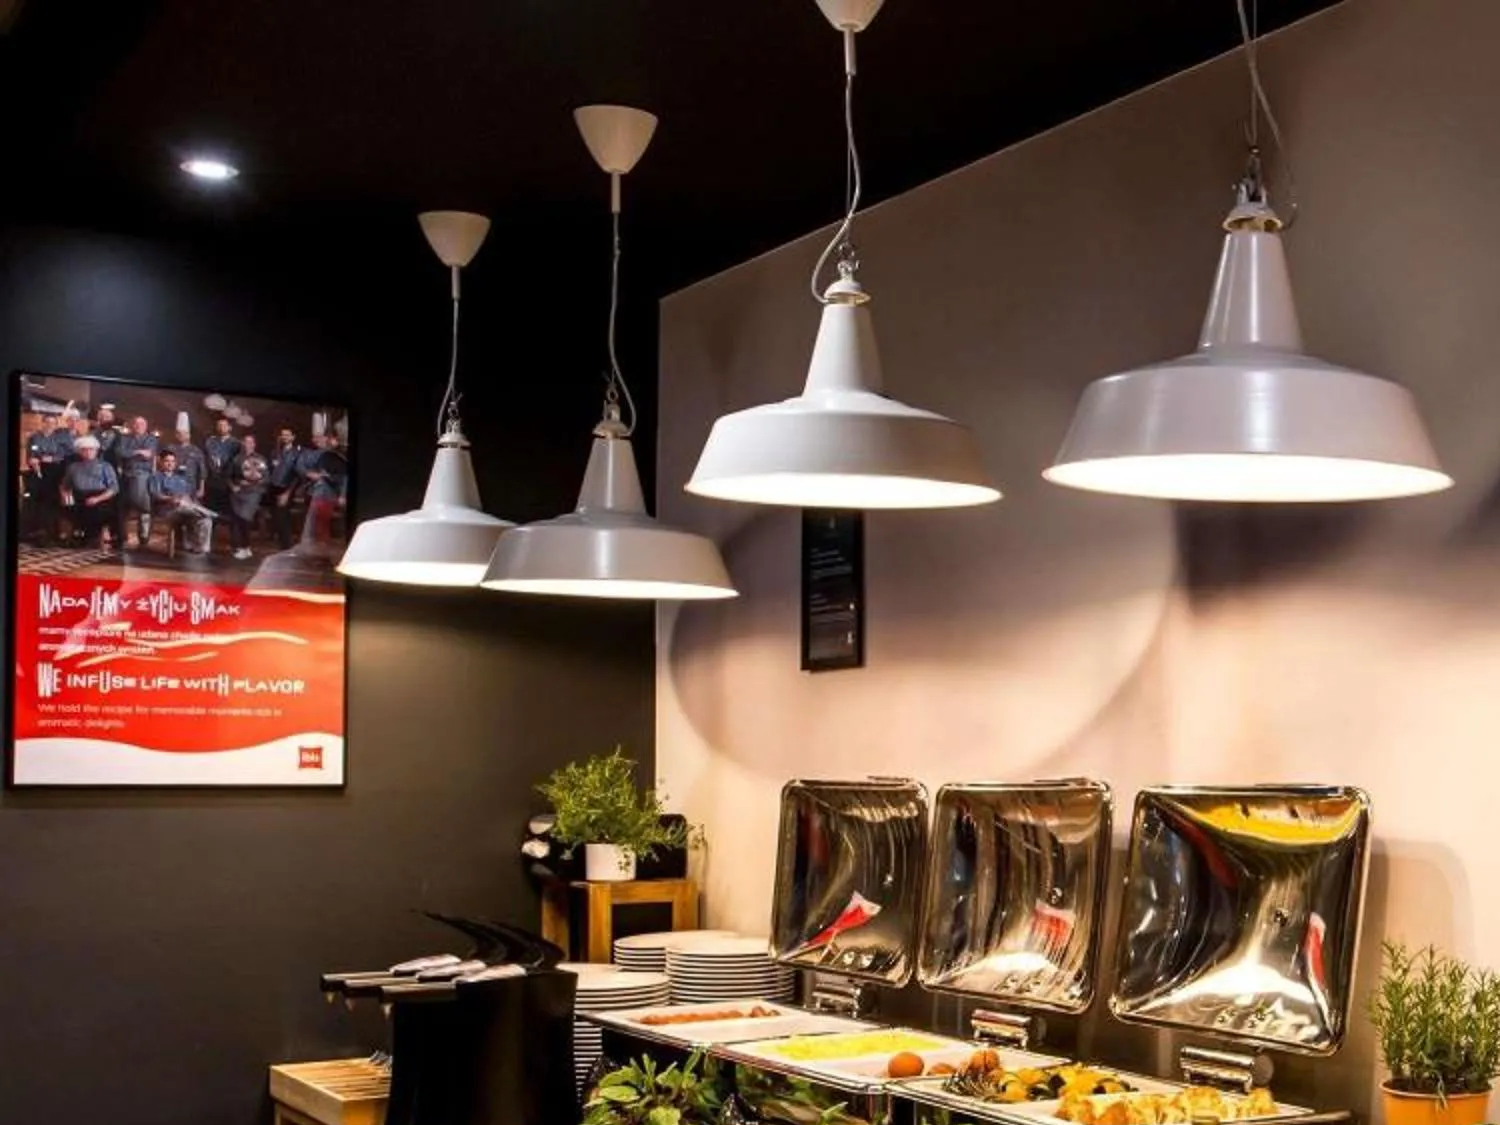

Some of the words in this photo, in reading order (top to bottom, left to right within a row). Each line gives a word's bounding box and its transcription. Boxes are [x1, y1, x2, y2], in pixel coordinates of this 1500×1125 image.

[191, 591, 241, 624] SMAK
[38, 661, 62, 697] WE
[67, 670, 136, 694] INFUSE
[140, 675, 180, 690] LIFE
[184, 673, 229, 697] WITH
[233, 679, 305, 695] FLAVOR
